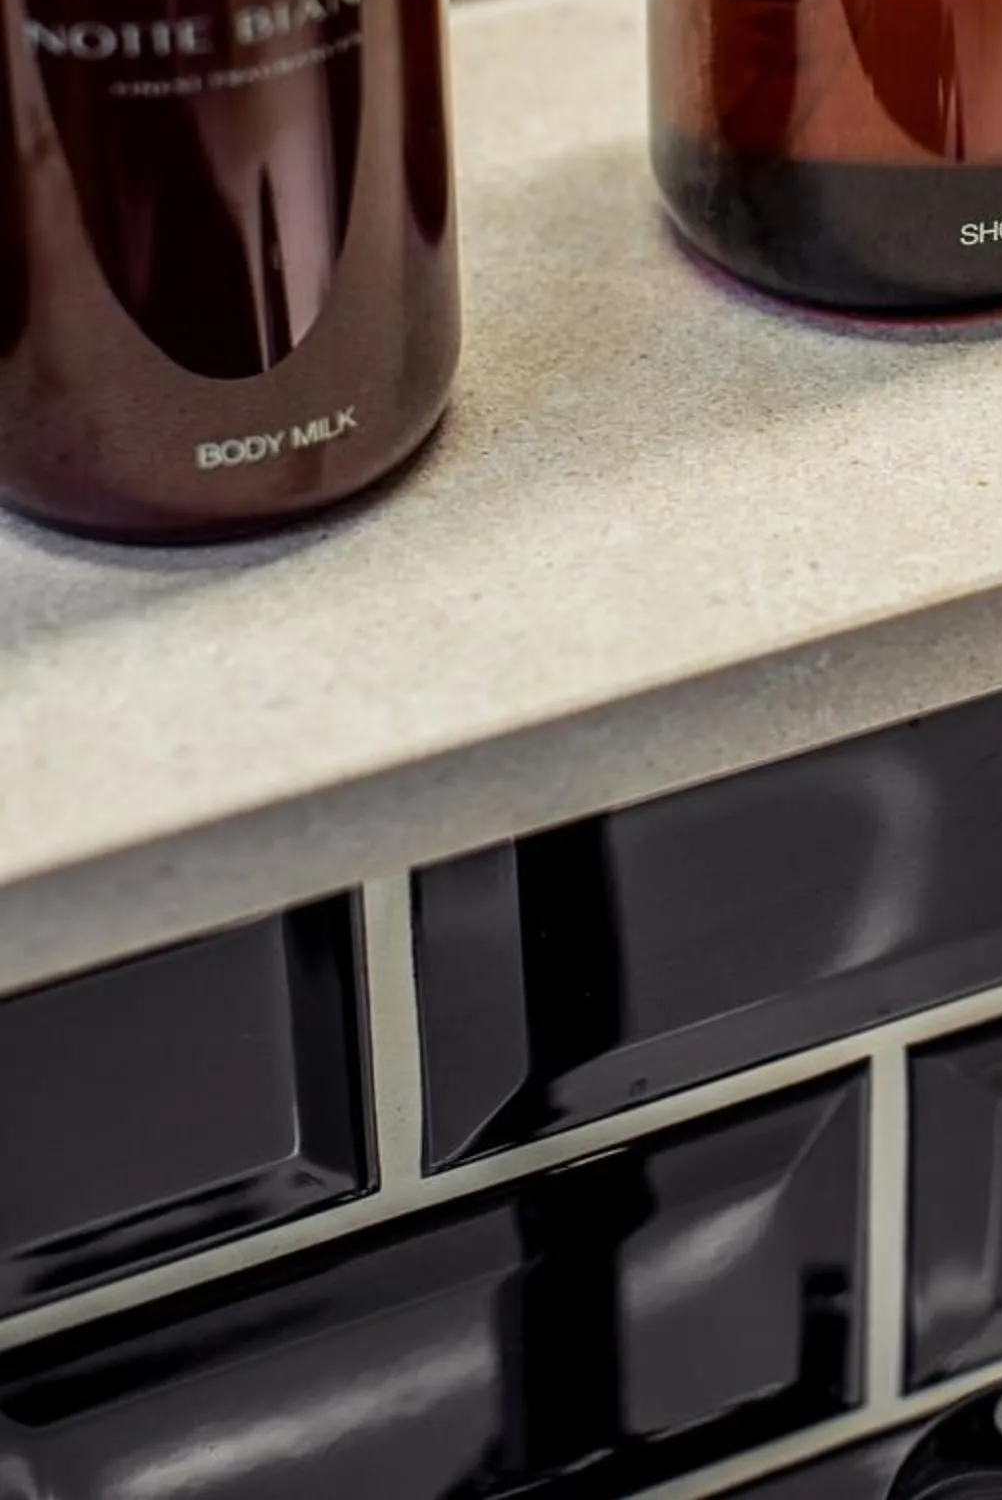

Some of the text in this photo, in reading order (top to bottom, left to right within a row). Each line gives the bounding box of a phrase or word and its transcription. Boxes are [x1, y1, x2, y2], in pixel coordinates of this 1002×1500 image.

[21, 16, 215, 61] NOTTE
[196, 403, 359, 472] BODY MILK
